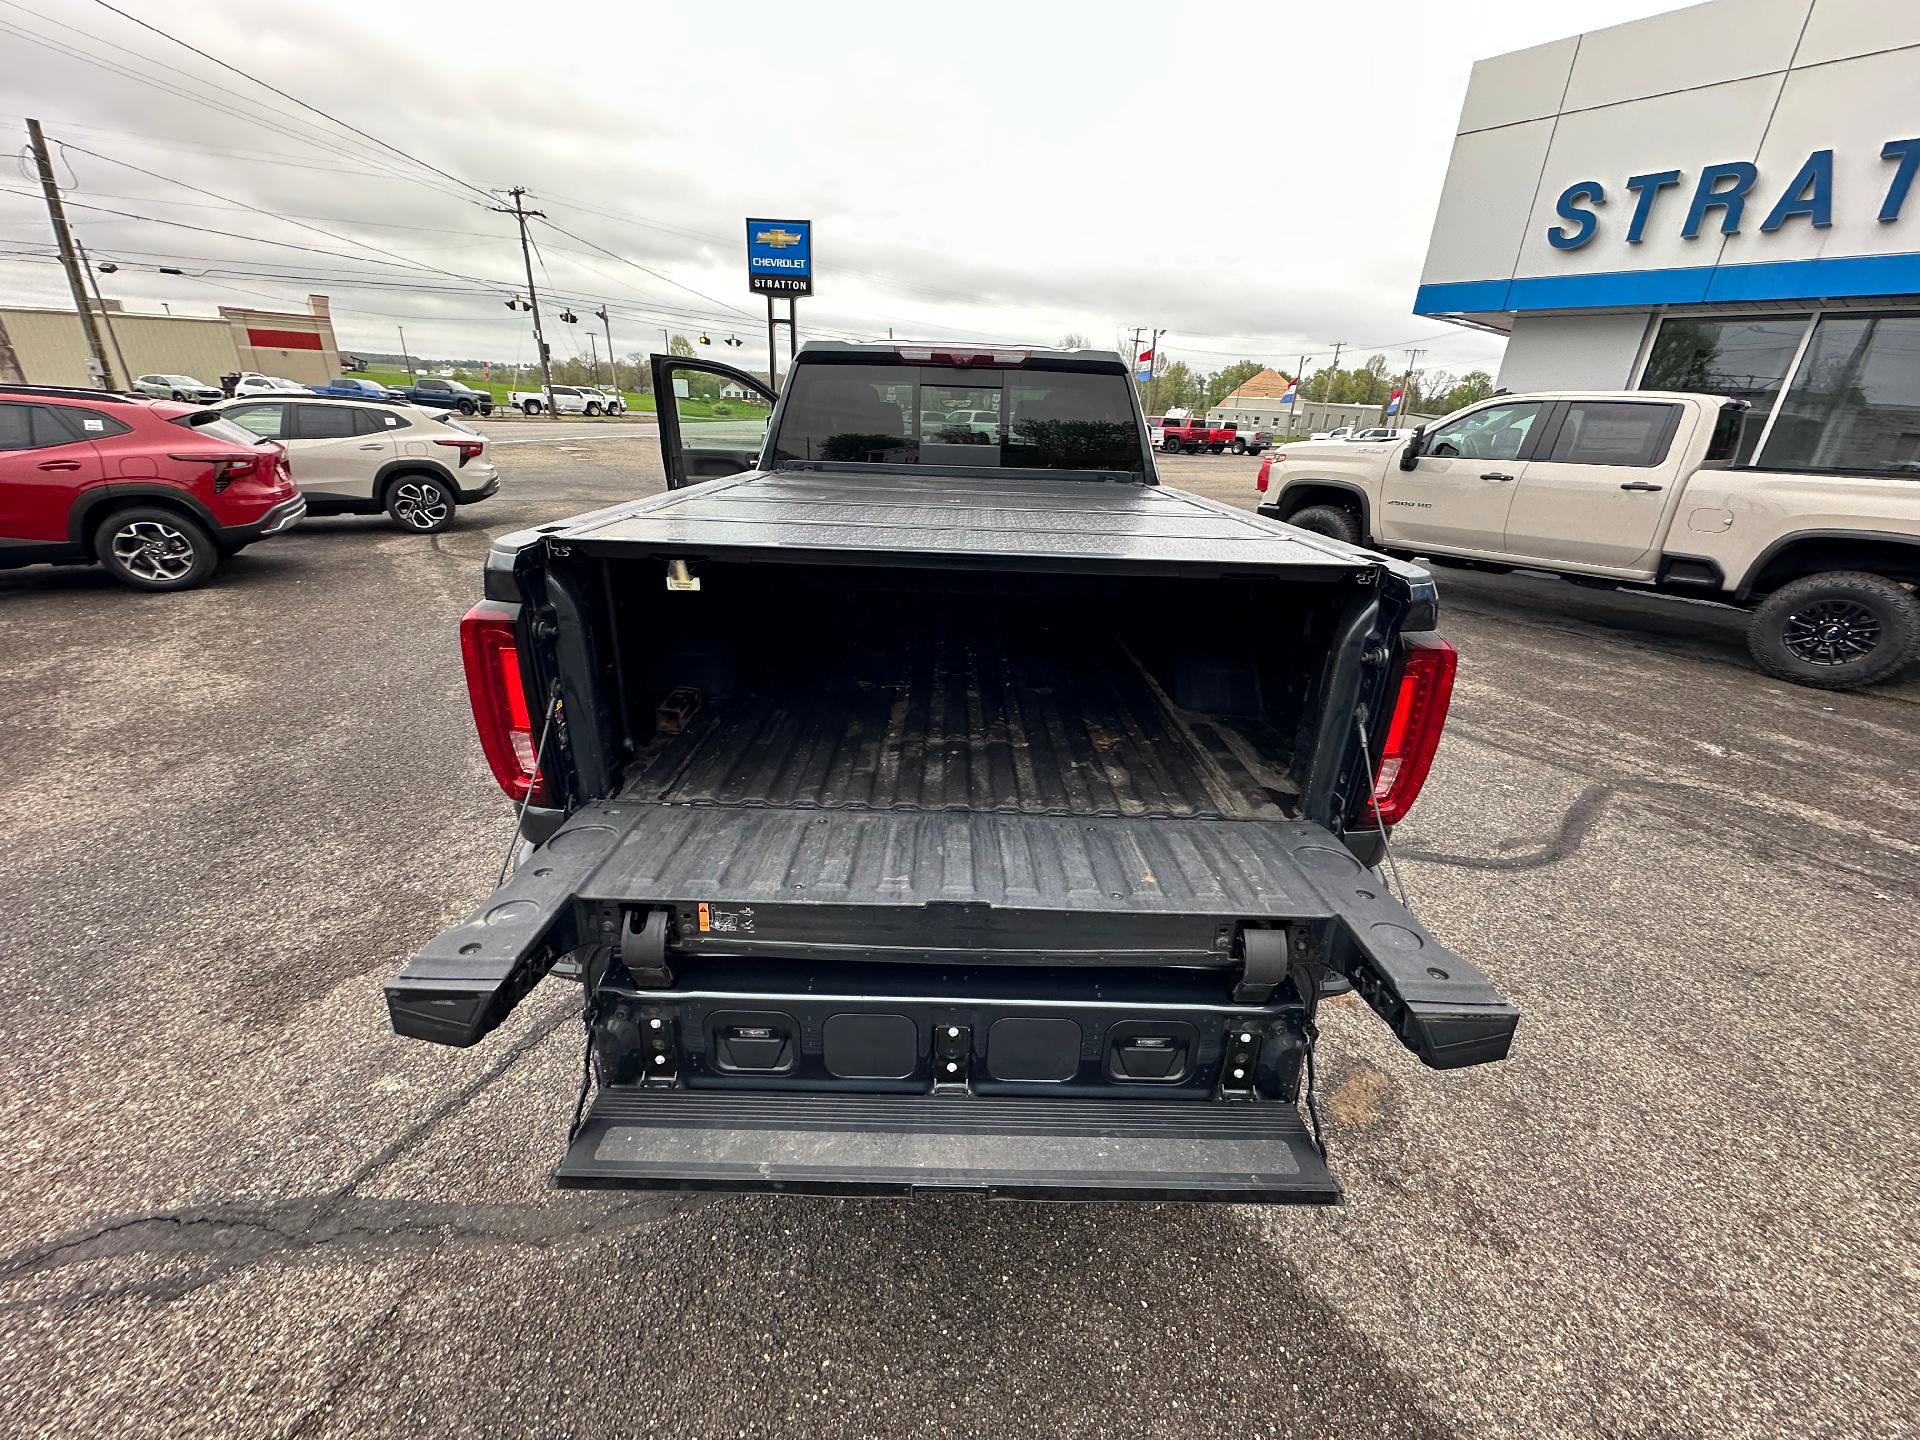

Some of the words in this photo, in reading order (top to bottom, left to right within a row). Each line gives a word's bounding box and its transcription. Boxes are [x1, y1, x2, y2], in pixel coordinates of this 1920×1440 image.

[1547, 137, 1920, 251] STRAT
[752, 257, 806, 269] CHEVROLET
[754, 279, 807, 290] STRATTON
